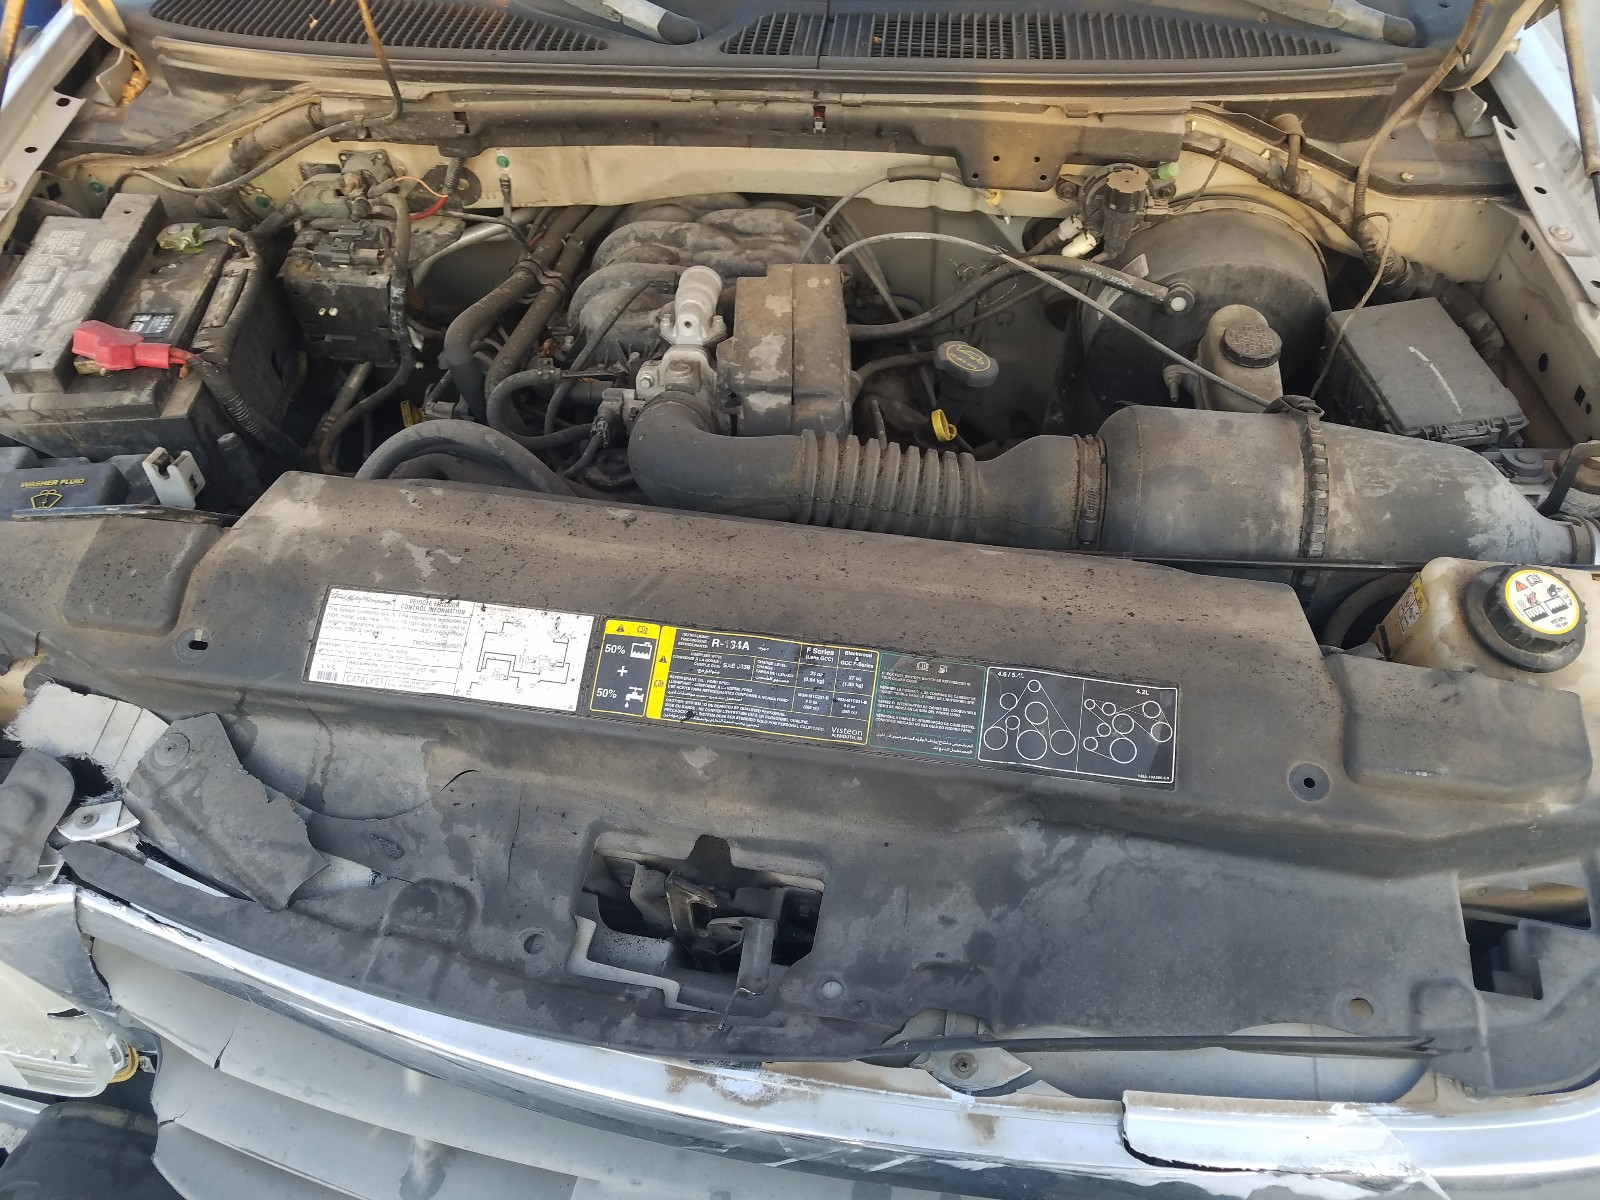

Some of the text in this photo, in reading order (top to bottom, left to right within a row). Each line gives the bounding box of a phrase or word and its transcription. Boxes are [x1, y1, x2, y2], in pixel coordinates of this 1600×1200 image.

[20, 480, 58, 488] WASHER
[400, 604, 466, 616] CONTROL INFORMATION
[604, 644, 626, 654] 50%
[712, 638, 750, 650] R-134A
[812, 647, 834, 656] Series
[346, 674, 384, 686] CATALYST
[596, 688, 617, 698] 50%
[832, 726, 862, 736] Visteon
